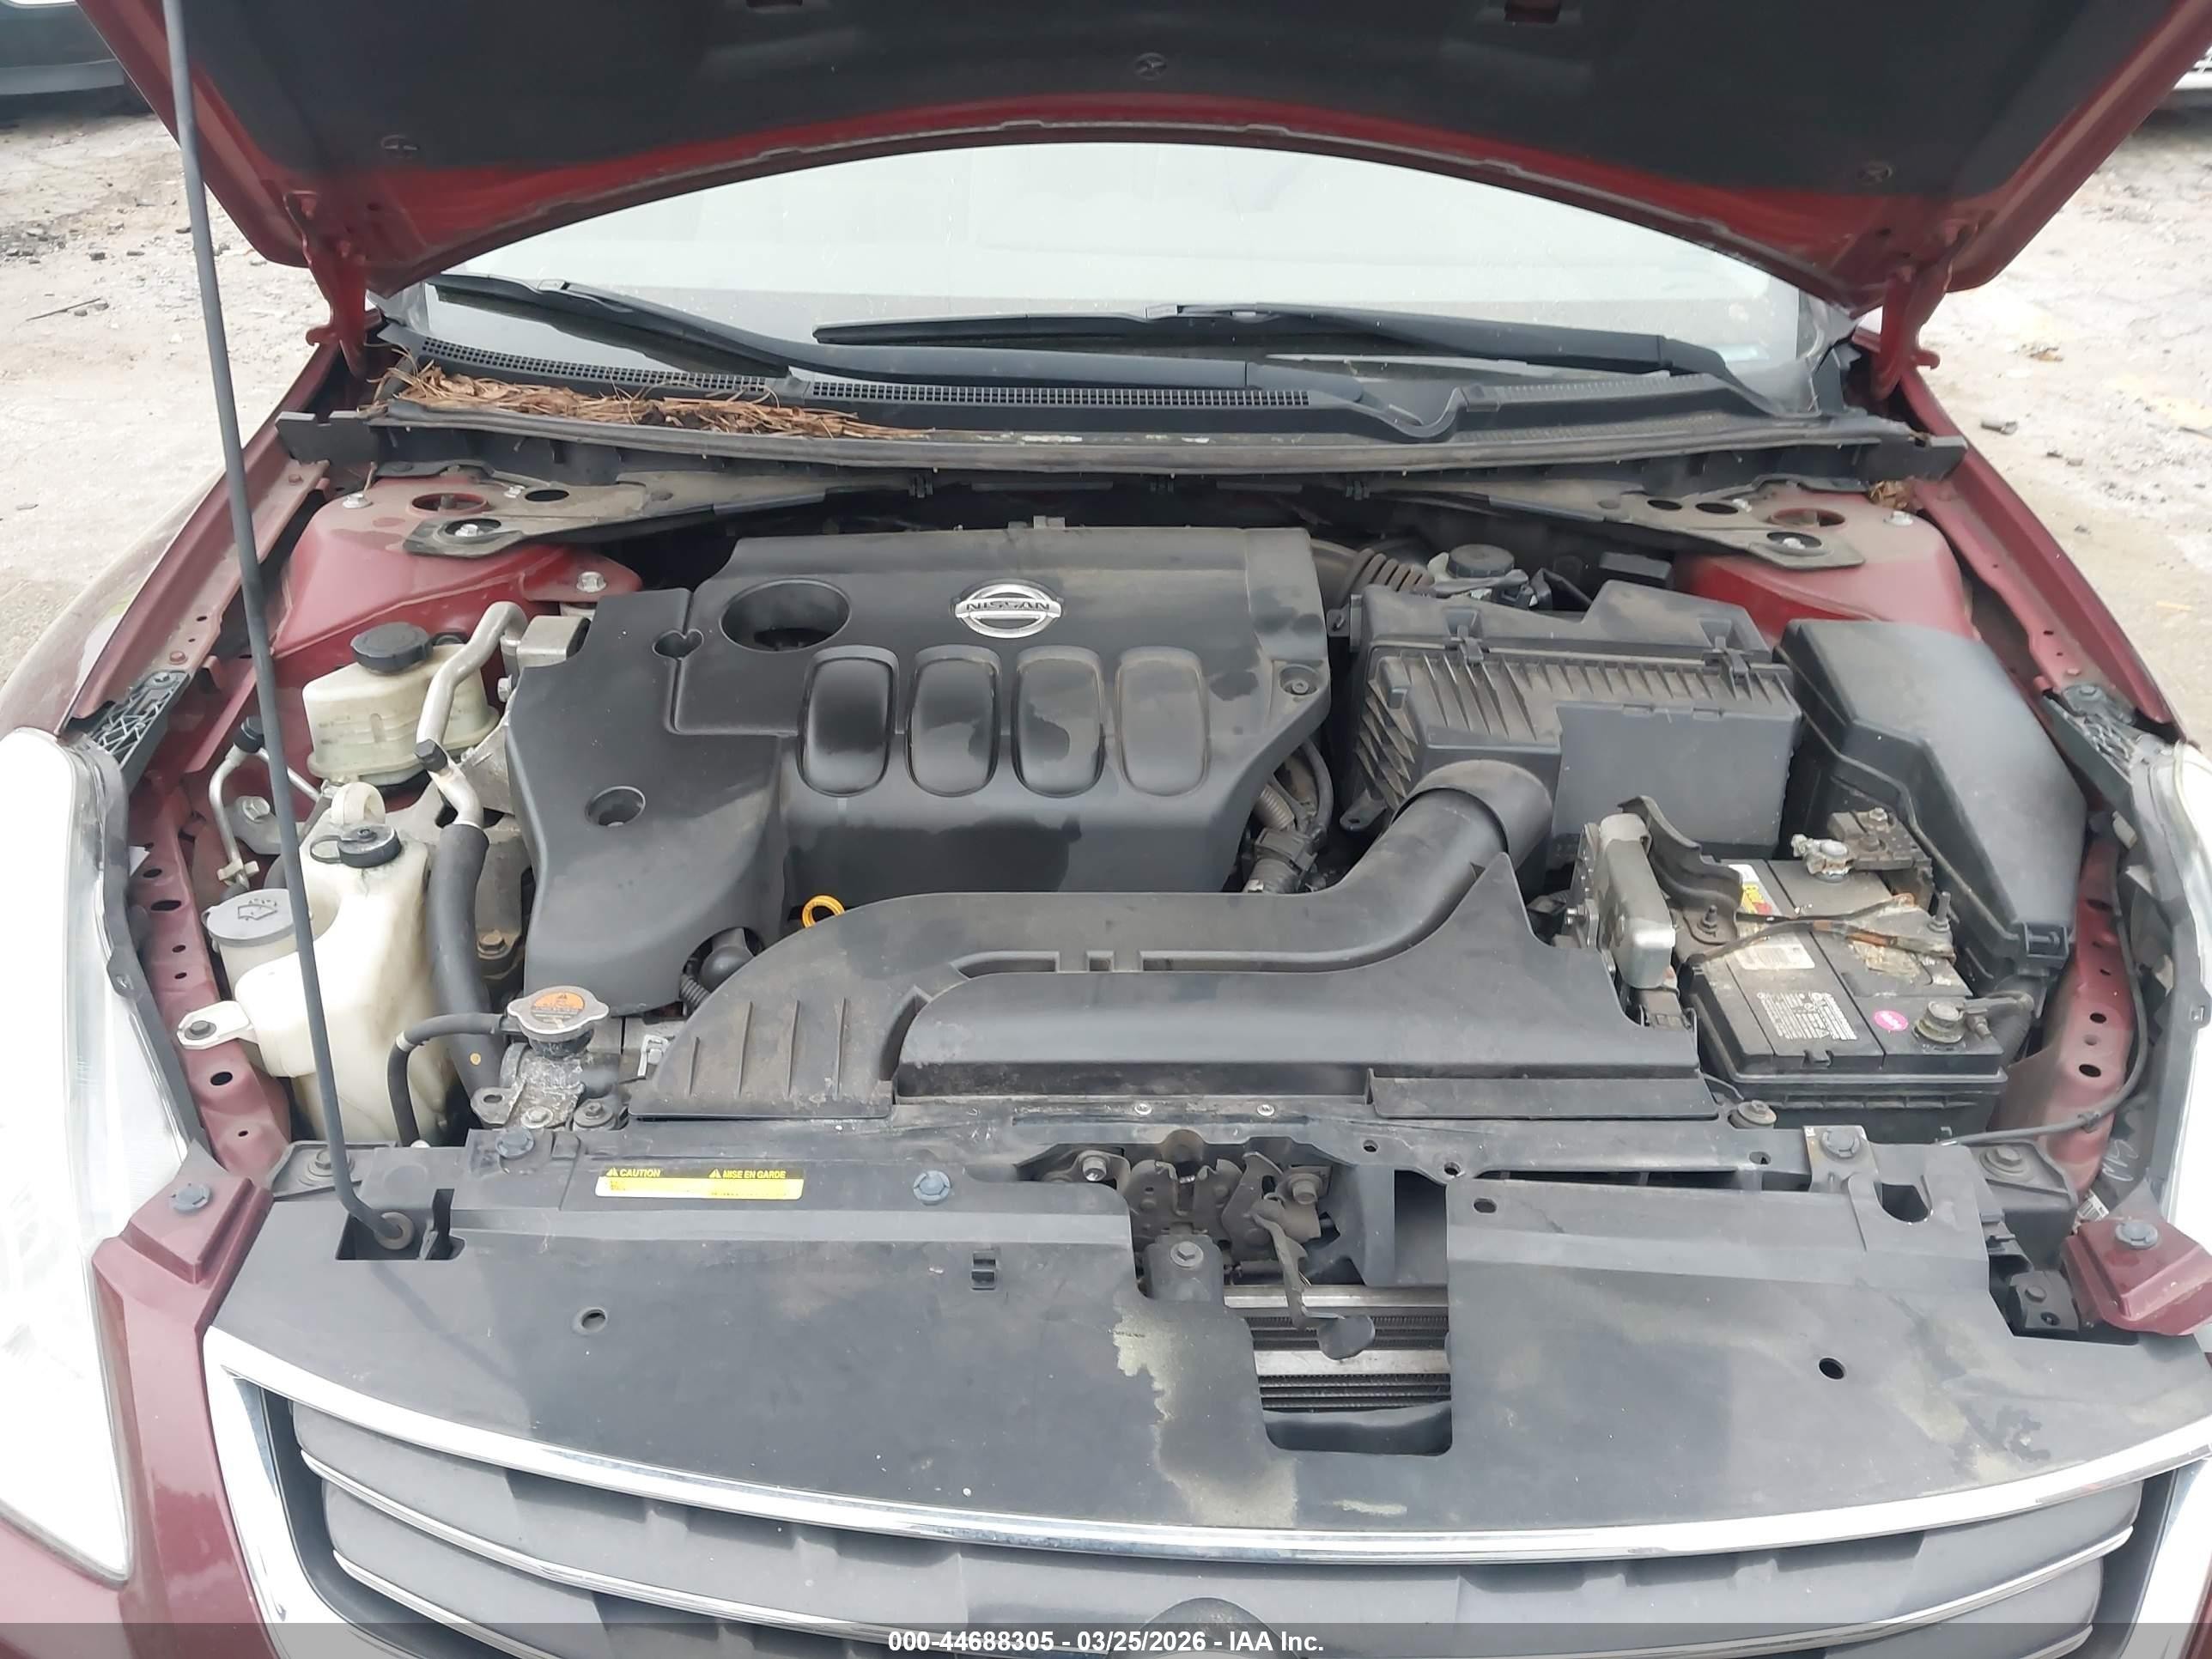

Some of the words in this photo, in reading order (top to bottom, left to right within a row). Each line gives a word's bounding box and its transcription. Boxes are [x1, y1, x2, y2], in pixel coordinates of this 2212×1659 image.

[966, 601, 1050, 611] NISSAN
[619, 1169, 661, 1177] CAUTION
[722, 1170, 744, 1179] MISE
[744, 1170, 757, 1179] EN
[757, 1170, 787, 1179] GARDE
